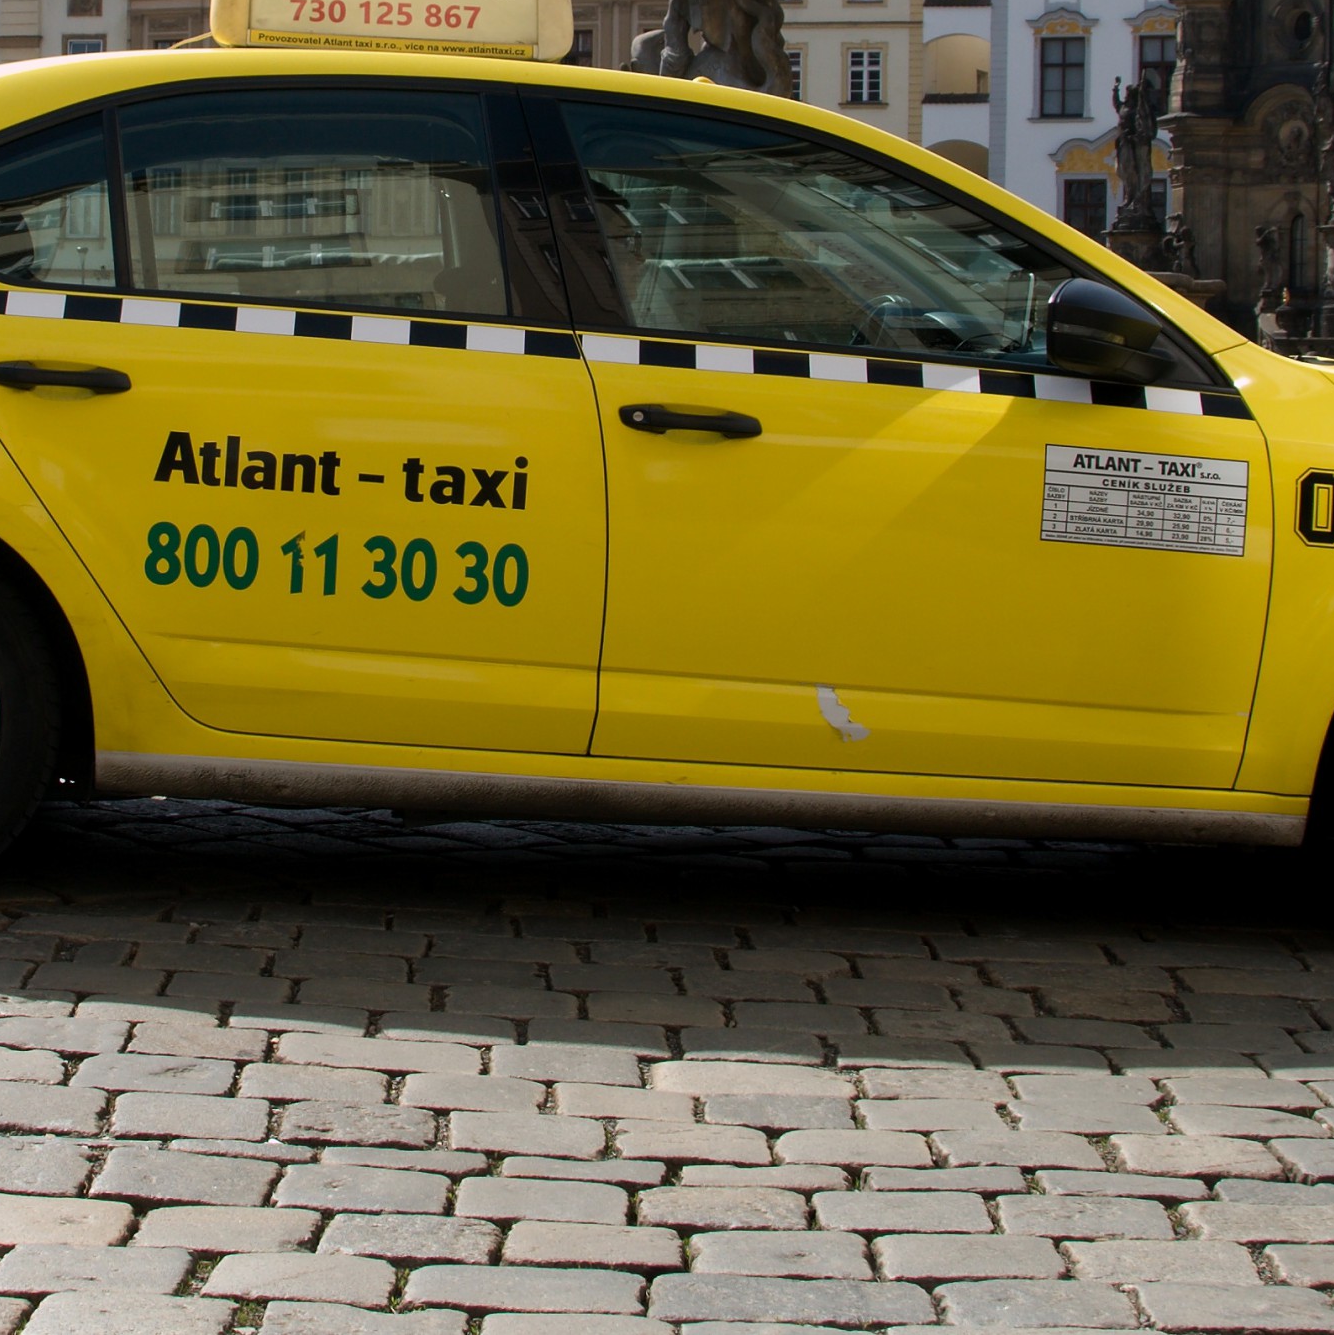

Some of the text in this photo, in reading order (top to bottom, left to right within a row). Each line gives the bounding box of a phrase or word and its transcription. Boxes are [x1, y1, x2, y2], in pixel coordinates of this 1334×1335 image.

[359, 0, 413, 26] 125
[424, 3, 482, 29] 867
[258, 33, 321, 45] Provozovatel
[323, 38, 352, 47] Atlant
[355, 40, 373, 48] taxi
[443, 45, 526, 57] www.atlanttaxi.cz
[154, 431, 341, 496] Atlant
[402, 456, 529, 510] taxi
[1073, 453, 1141, 473] ATLANT
[1200, 472, 1221, 480] s.r.o.
[1102, 478, 1191, 493] CENÍK SLUŽEB
[144, 521, 529, 607] 800 11 30 30
